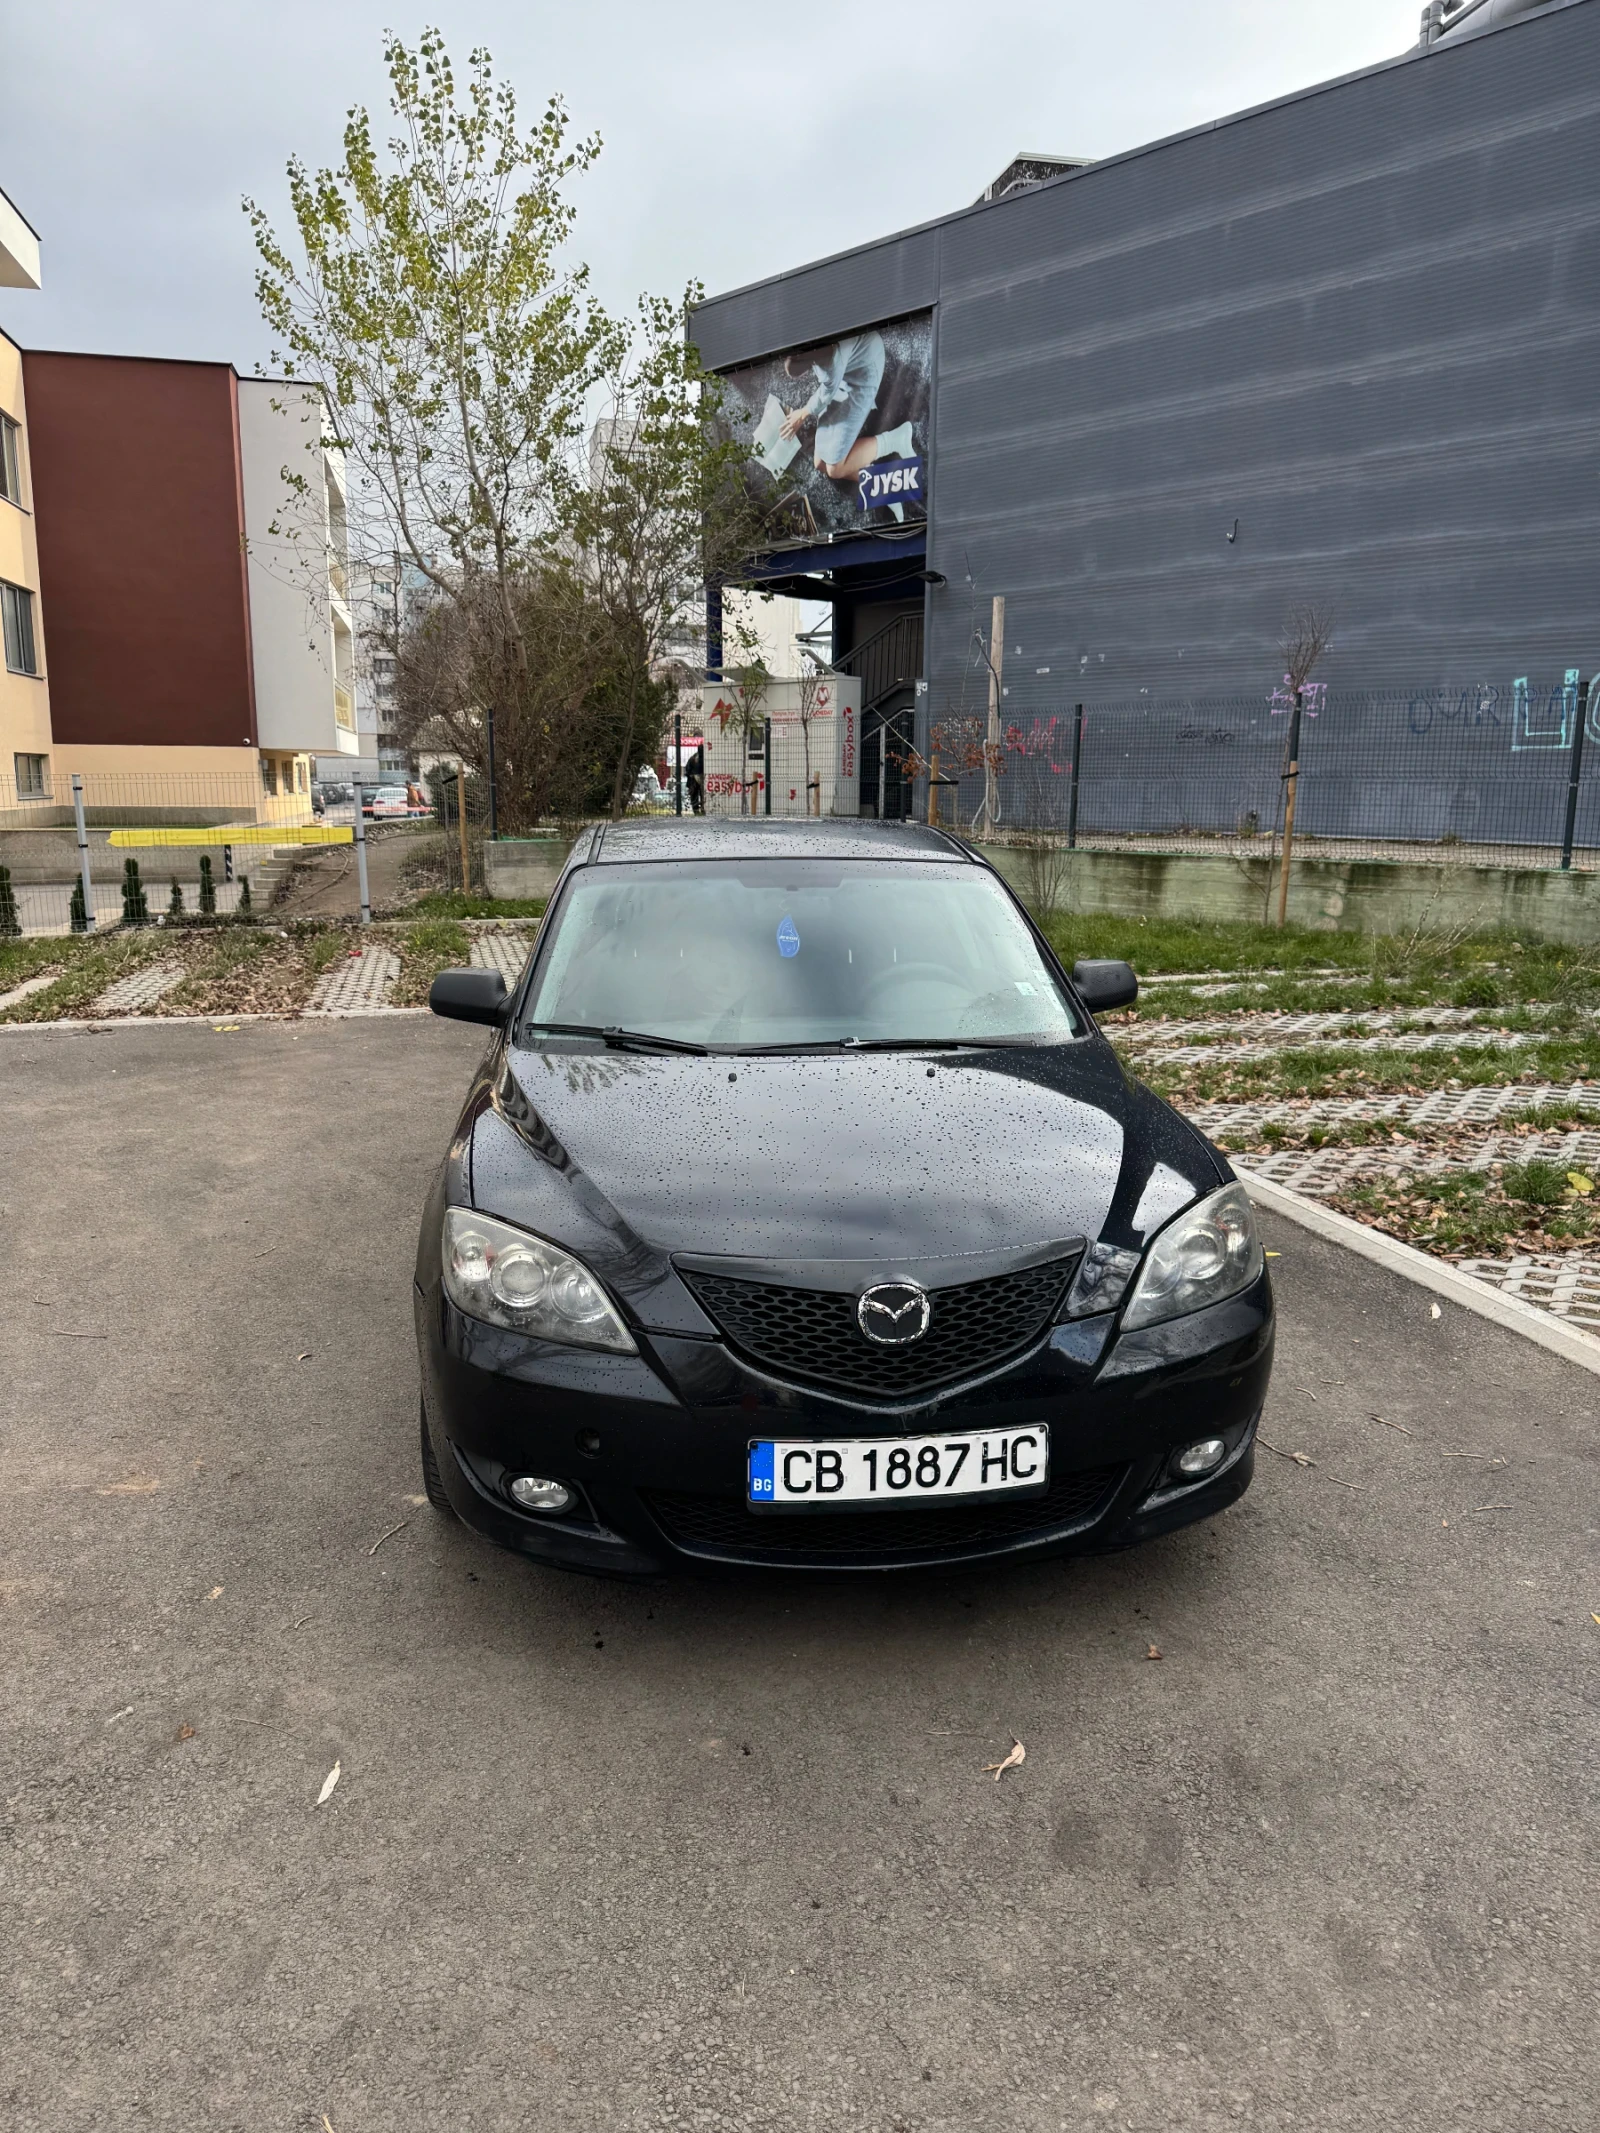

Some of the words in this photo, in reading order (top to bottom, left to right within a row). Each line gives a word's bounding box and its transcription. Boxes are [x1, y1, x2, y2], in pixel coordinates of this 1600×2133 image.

[870, 467, 919, 497] JYSK
[845, 715, 856, 777] easybox
[707, 778, 752, 797] easybo
[783, 1449, 845, 1494] CB
[862, 1443, 971, 1491] 1887
[980, 1434, 1038, 1484] HC
[753, 1478, 772, 1492] BG
